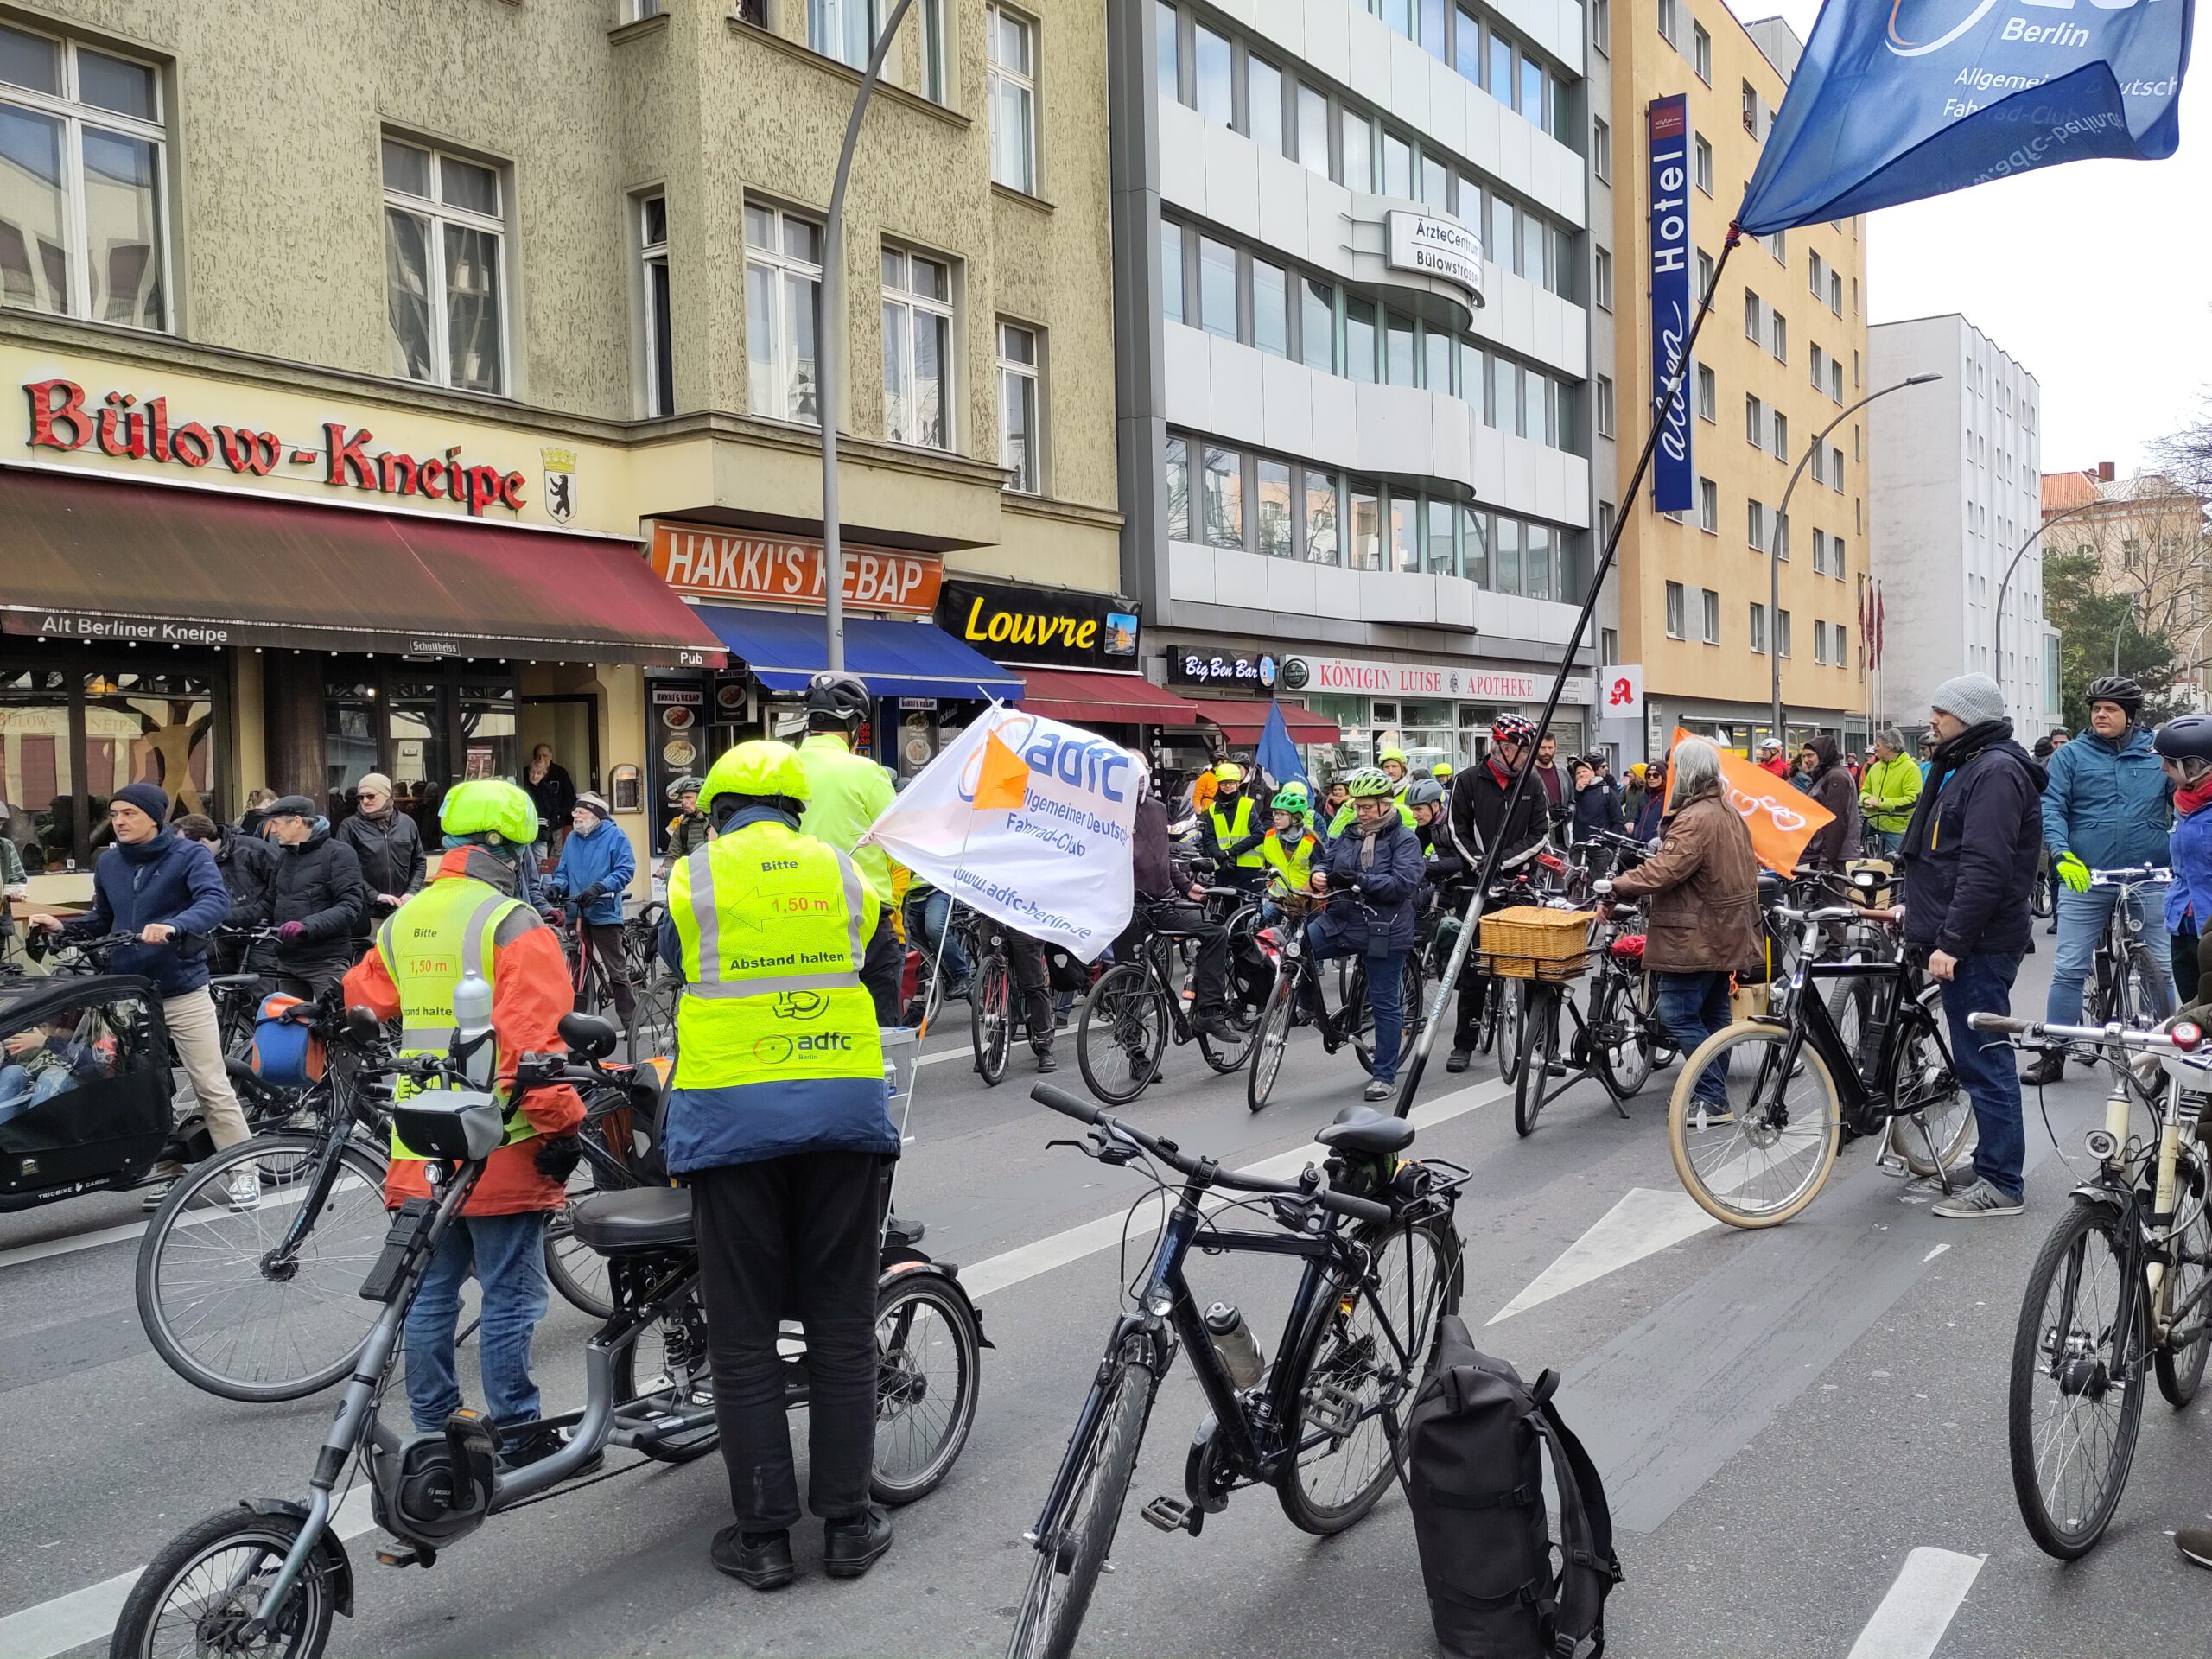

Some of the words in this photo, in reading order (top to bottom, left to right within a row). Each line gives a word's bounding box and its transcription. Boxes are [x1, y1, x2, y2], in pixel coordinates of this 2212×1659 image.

[2001, 16, 2090, 48] Berlin
[1954, 67, 2050, 92] Allgemei
[1653, 150, 1685, 274] Hotel
[1416, 218, 1479, 259] ÄrzteCentrum
[1416, 251, 1478, 284] Bülowstrasse
[664, 532, 805, 595] HAKKI'S
[41, 616, 71, 633] Alt
[77, 618, 157, 639] Berliner
[162, 623, 228, 645] Kneipe
[965, 596, 1098, 649] Louvre
[413, 640, 457, 653] Schultheiss
[680, 652, 703, 665] Pub
[1185, 655, 1210, 682] Big
[1210, 657, 1233, 678] Ben
[1235, 658, 1259, 679] Bar
[1320, 659, 1391, 690] KÖNIGIN
[1399, 671, 1442, 692] LUISE
[1467, 675, 1534, 697] APOTHEKE
[938, 703, 958, 725] ocktail
[1025, 733, 1129, 804] adfc
[1154, 779, 1162, 798] BA
[1023, 787, 1086, 827] llgemeiner
[1006, 812, 1086, 857] Fahrrad-Club
[761, 860, 798, 872] Bitte
[772, 897, 809, 914] 1,50
[813, 899, 830, 912] m
[953, 868, 1093, 940] www.adfc-berlinde
[413, 928, 437, 938] Bitte
[410, 959, 432, 976] 1,50
[435, 962, 448, 972] m
[729, 953, 795, 971] Abstand
[800, 951, 844, 964] halten
[423, 1007, 455, 1017] halte
[797, 1032, 852, 1052] adfc
